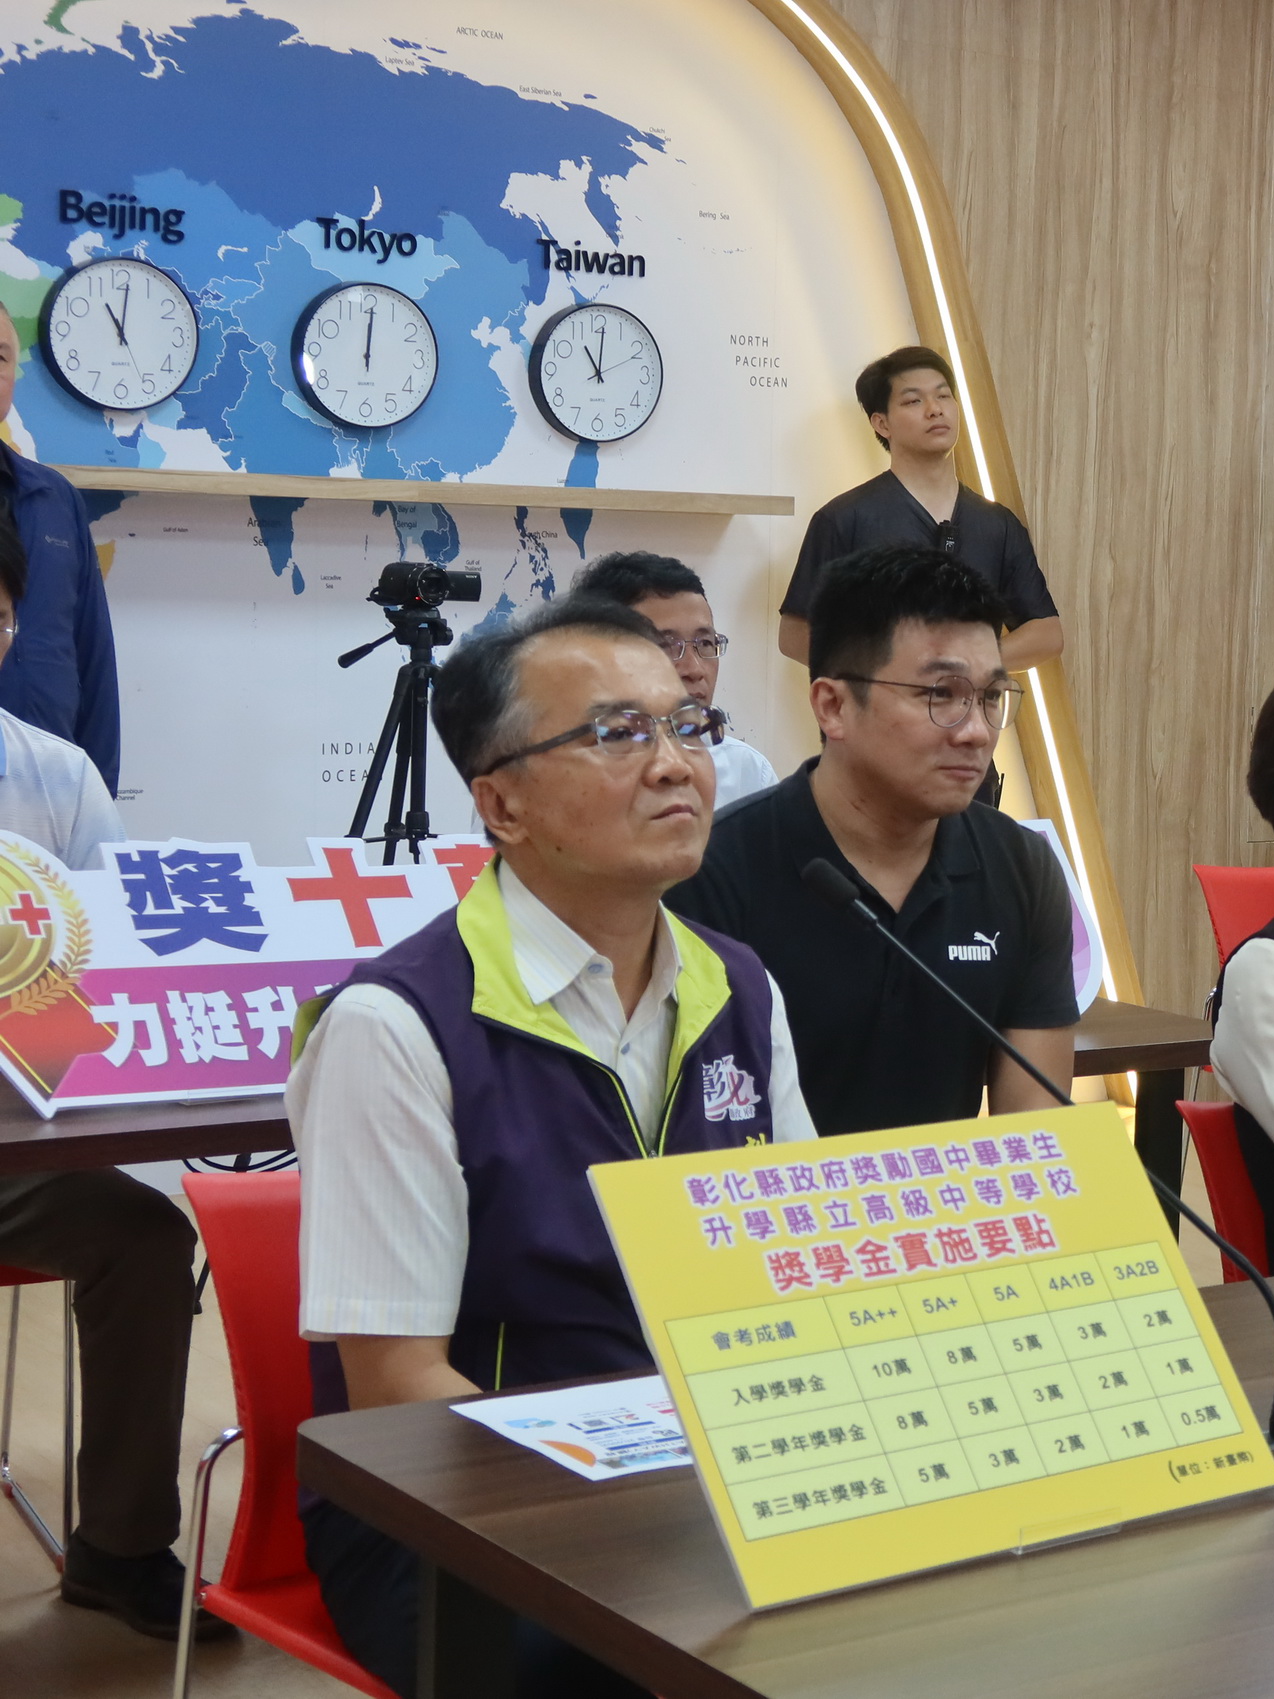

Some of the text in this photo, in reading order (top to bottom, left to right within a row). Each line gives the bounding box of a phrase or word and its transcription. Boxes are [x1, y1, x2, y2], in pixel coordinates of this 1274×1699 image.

[456, 26, 504, 40] ARCTIC OCEAN
[385, 55, 415, 67] Laptev Sea
[519, 85, 530, 93] East
[531, 86, 551, 96] Siberian
[59, 189, 185, 245] Beijing
[699, 210, 730, 221] Bering Sea
[316, 217, 418, 264] Tokyo
[536, 238, 646, 278] Taiwan
[87, 276, 103, 298] 11
[111, 268, 131, 290] 12
[146, 278, 150, 299] 1
[65, 296, 90, 318] 10
[160, 299, 176, 320] 2
[338, 300, 352, 321] 11
[359, 293, 378, 315] 12
[391, 303, 395, 322] 1
[55, 320, 70, 342] 9
[317, 318, 340, 339] 10
[404, 322, 418, 343] 2
[571, 321, 584, 340] 11
[590, 314, 607, 334] 12
[618, 322, 623, 341] 1
[171, 327, 185, 348] 3
[730, 334, 769, 347] NORTH
[307, 341, 322, 361] 9
[412, 349, 425, 369] 3
[552, 339, 573, 359] 10
[630, 340, 644, 360] 2
[66, 349, 81, 371] 8
[160, 354, 174, 374] 4
[735, 355, 780, 368] PACIFIC
[88, 370, 101, 391] 7
[316, 368, 330, 390] 8
[544, 361, 557, 381] 9
[639, 365, 651, 386] 3
[113, 378, 129, 399] 6
[141, 373, 156, 395] 5
[401, 375, 414, 394] 4
[749, 376, 788, 388] OCEAN
[336, 390, 348, 410] 7
[384, 393, 398, 413] 5
[552, 386, 565, 407] 8
[629, 390, 641, 409] 4
[359, 397, 373, 418] 6
[570, 406, 581, 425] 7
[614, 408, 626, 428] 5
[591, 412, 604, 433] 6
[397, 520, 417, 530] Bengal
[541, 530, 558, 538] China
[322, 743, 375, 755] INDIA
[322, 769, 383, 782] OCEA
[948, 945, 991, 961] PUMA
[92, 984, 345, 1068] 力挺升
[686, 1132, 1063, 1207] 彰化縣政府獎勵國中畢業生
[703, 1168, 1078, 1247] 升學縣立高級中等學校
[767, 1214, 1057, 1292] 獎學金實施要點
[711, 1260, 1159, 1351] 會考成績 5A++ 5A+ 5A 4A1B 3A2B
[731, 1309, 1173, 1407] 入學獎學金 10萬 8萬 5萬 3萬 2萬
[731, 1358, 1194, 1465] 第二學年獎學金 8萬 5萬 3萬 2萬 1萬
[752, 1405, 1222, 1520] 第三學年獎學金 5萬 3萬 2萬 1萬 0.5萬
